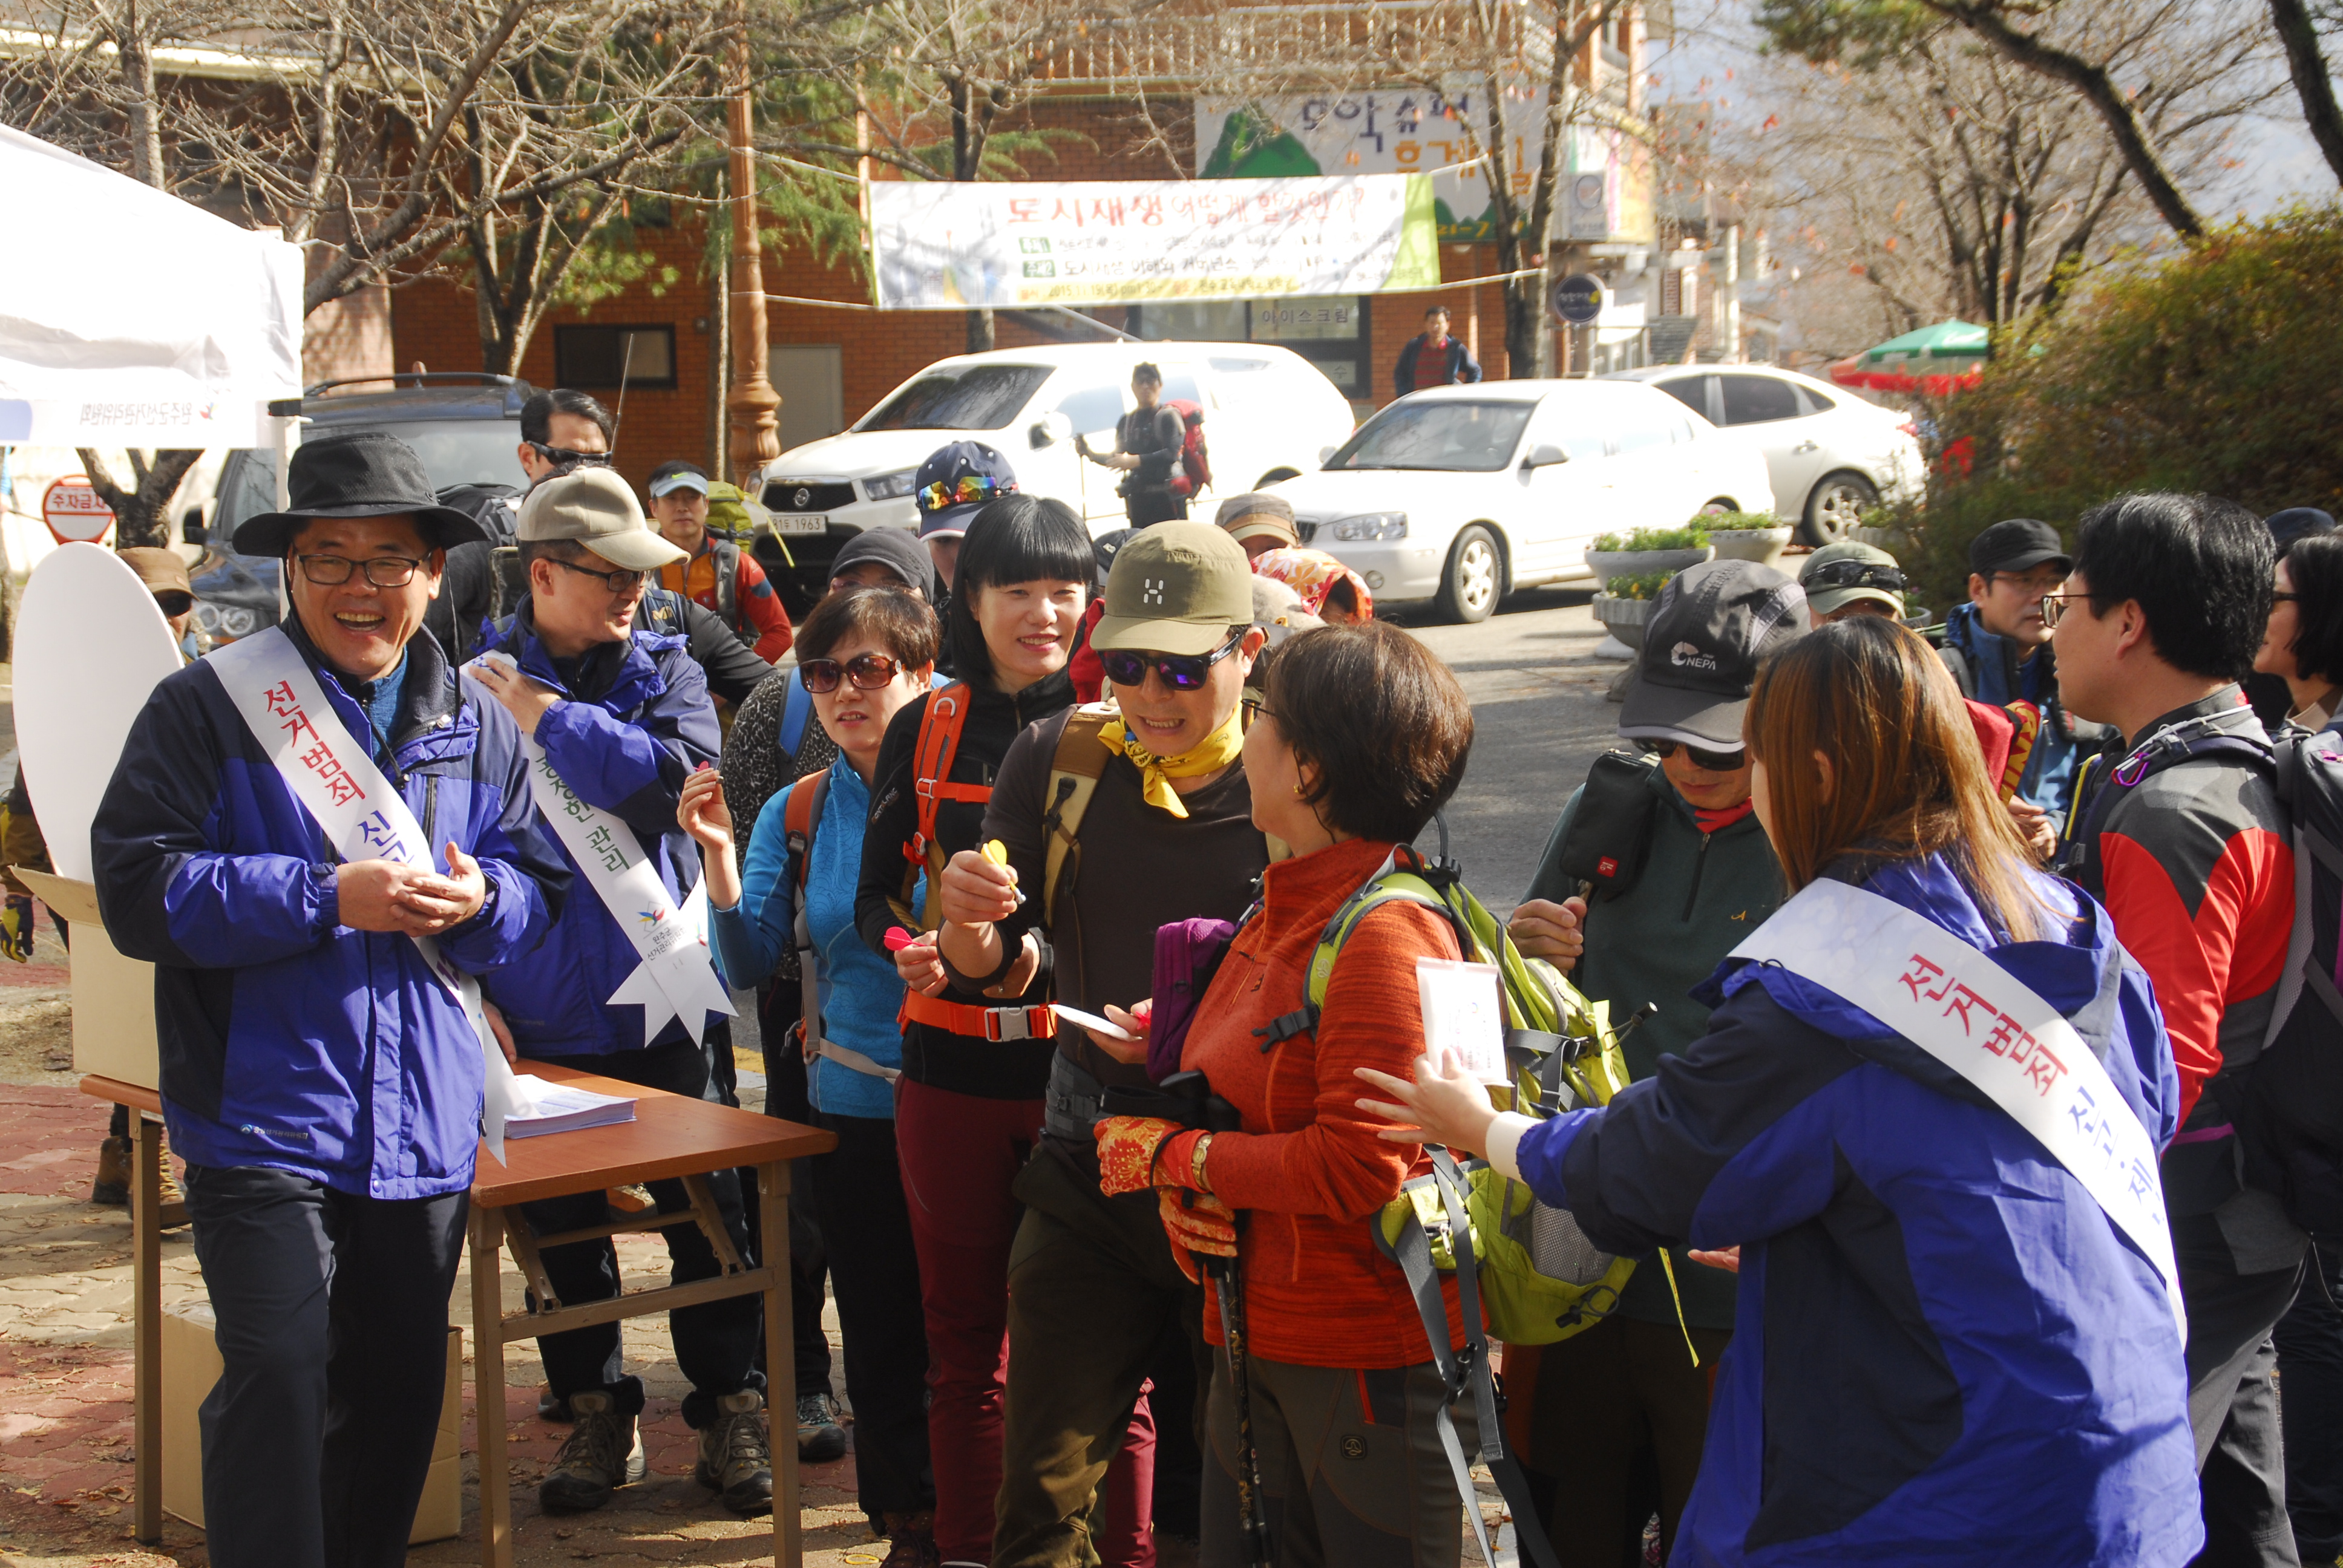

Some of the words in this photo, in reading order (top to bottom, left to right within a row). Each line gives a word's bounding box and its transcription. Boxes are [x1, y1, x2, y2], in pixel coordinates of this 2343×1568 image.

[1008, 195, 1164, 227] 도시재생
[1262, 308, 1349, 324] 아이스크림
[795, 517, 820, 531] 1963
[1686, 656, 1716, 670] NEPA
[263, 680, 365, 807] 선거범죄
[585, 825, 631, 872] 관리
[652, 927, 670, 945] 완주군
[1898, 953, 2069, 1097] 선거범죄
